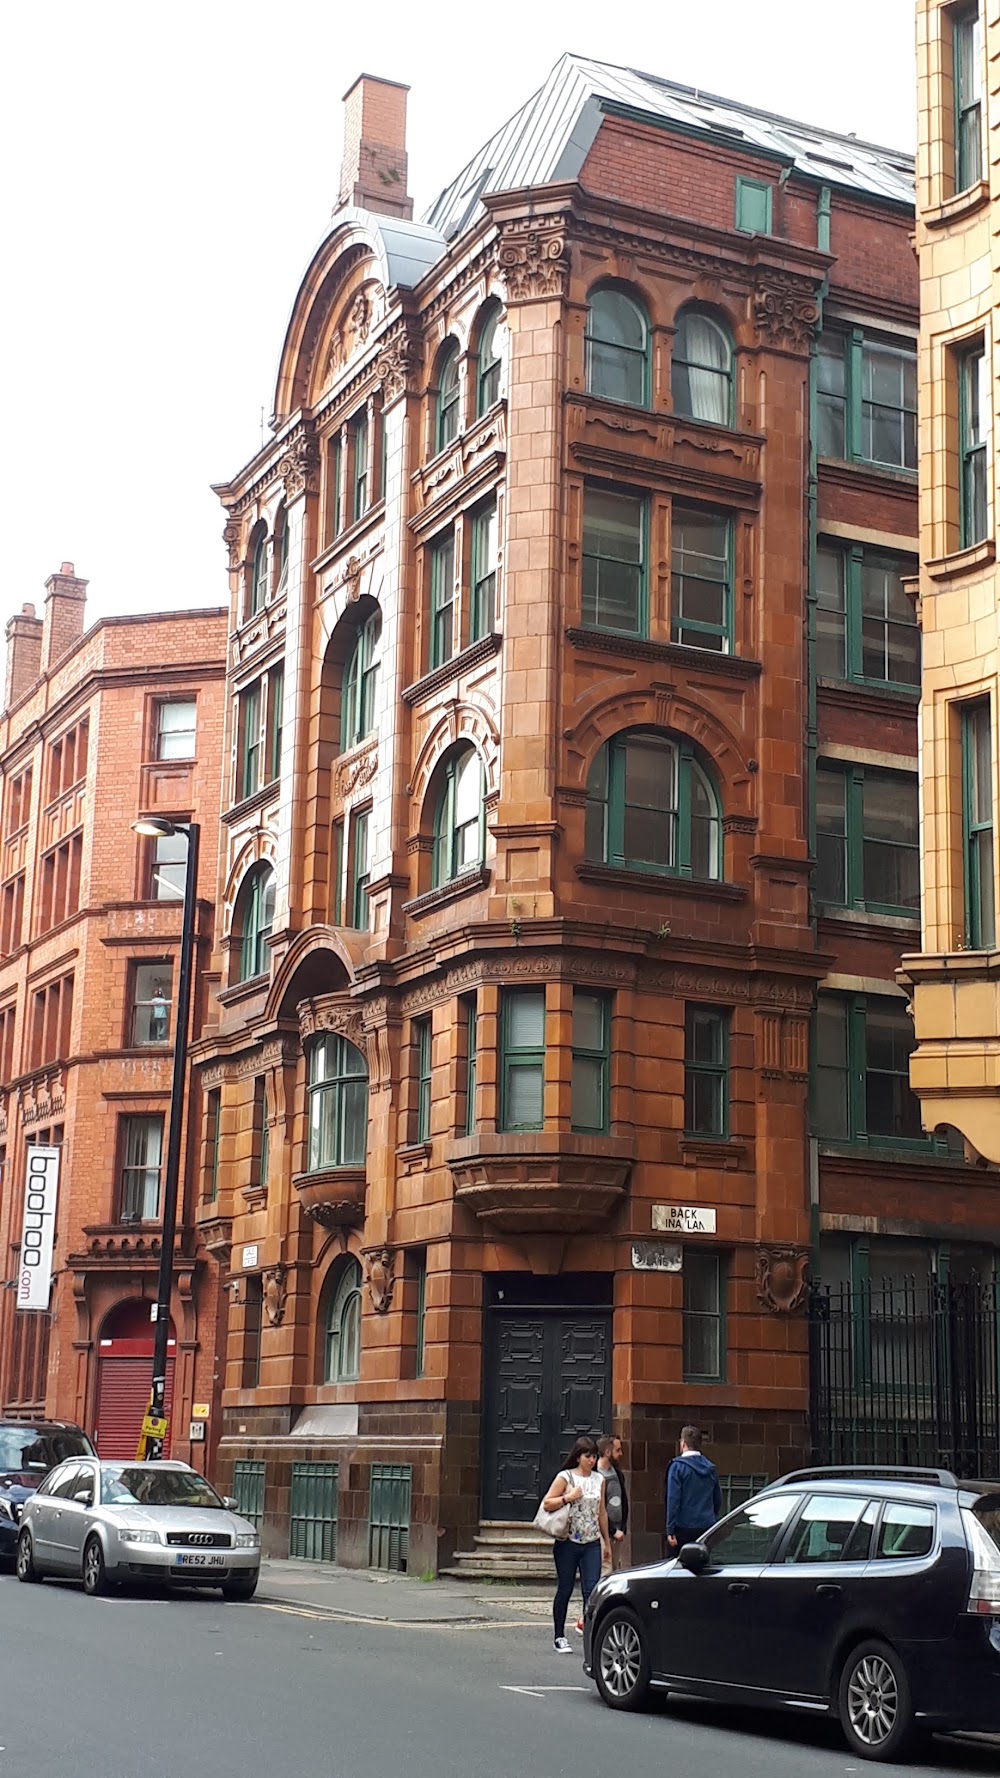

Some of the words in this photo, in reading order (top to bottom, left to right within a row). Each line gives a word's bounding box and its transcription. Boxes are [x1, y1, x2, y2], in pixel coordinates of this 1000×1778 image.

[670, 1207, 697, 1219] BACK
[182, 1554, 206, 1565] RE52
[208, 1555, 225, 1565] JHU
